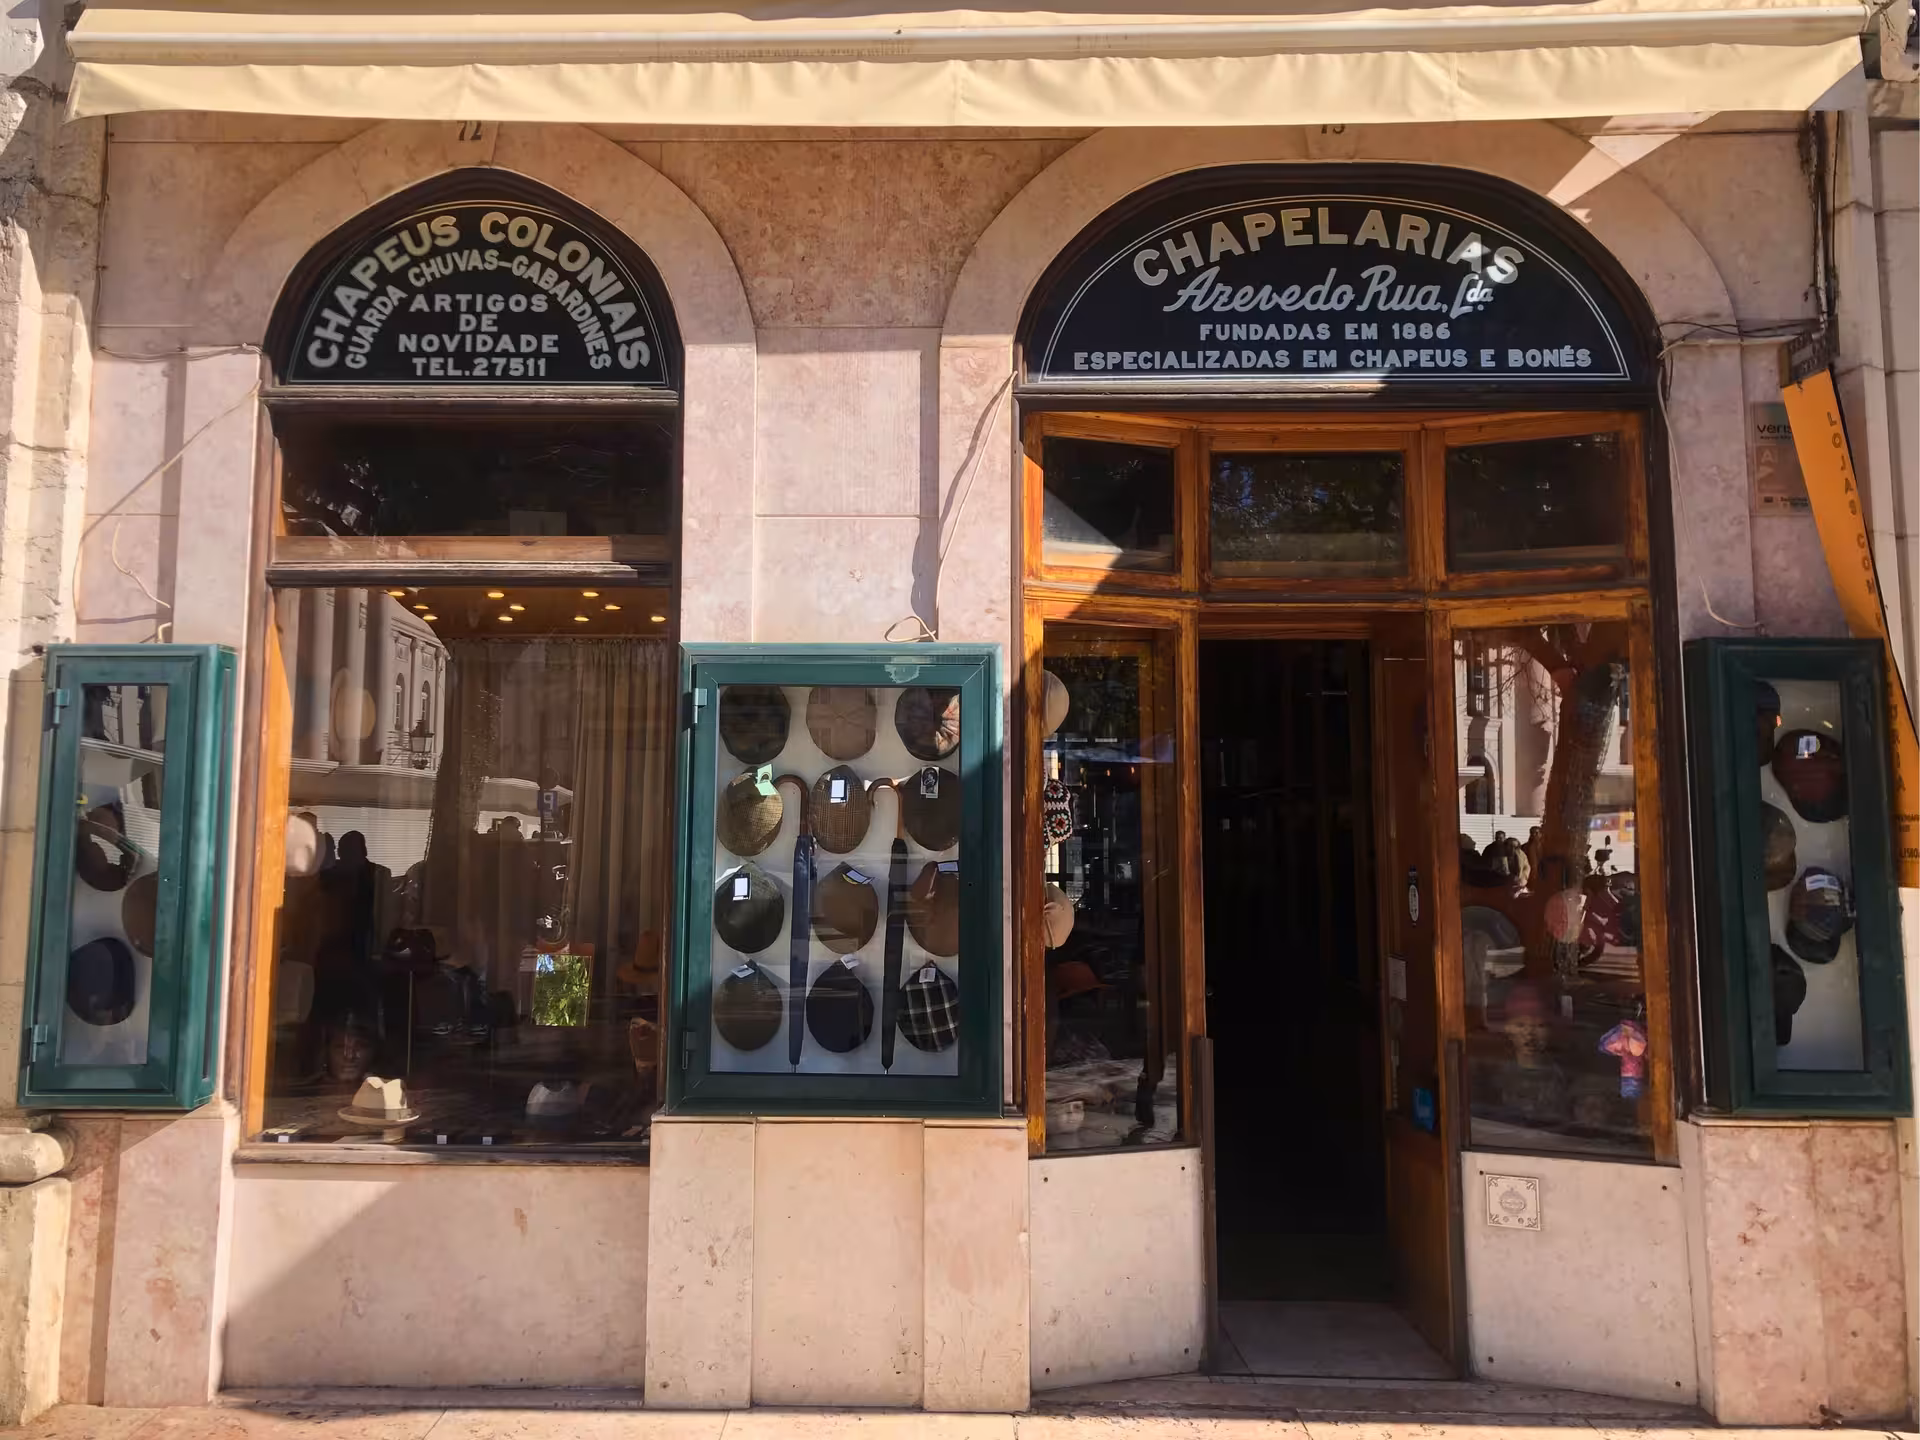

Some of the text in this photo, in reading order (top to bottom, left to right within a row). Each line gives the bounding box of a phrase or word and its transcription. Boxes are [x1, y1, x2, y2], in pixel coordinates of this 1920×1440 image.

[1133, 207, 1525, 287] CHAPELARIAS
[307, 211, 651, 370] CHAPEUS COLONIAIS
[1162, 264, 1355, 312] Azevedo
[408, 293, 549, 313] ARTIGOS
[345, 284, 407, 369] GUARDA
[458, 314, 498, 333] DE
[1199, 321, 1451, 341] FUNDADAS EM 1886
[398, 334, 560, 354] NOVIDADE
[1073, 345, 1592, 370] ESPECIALIZADAS EM CHAPEUS E BONÉS
